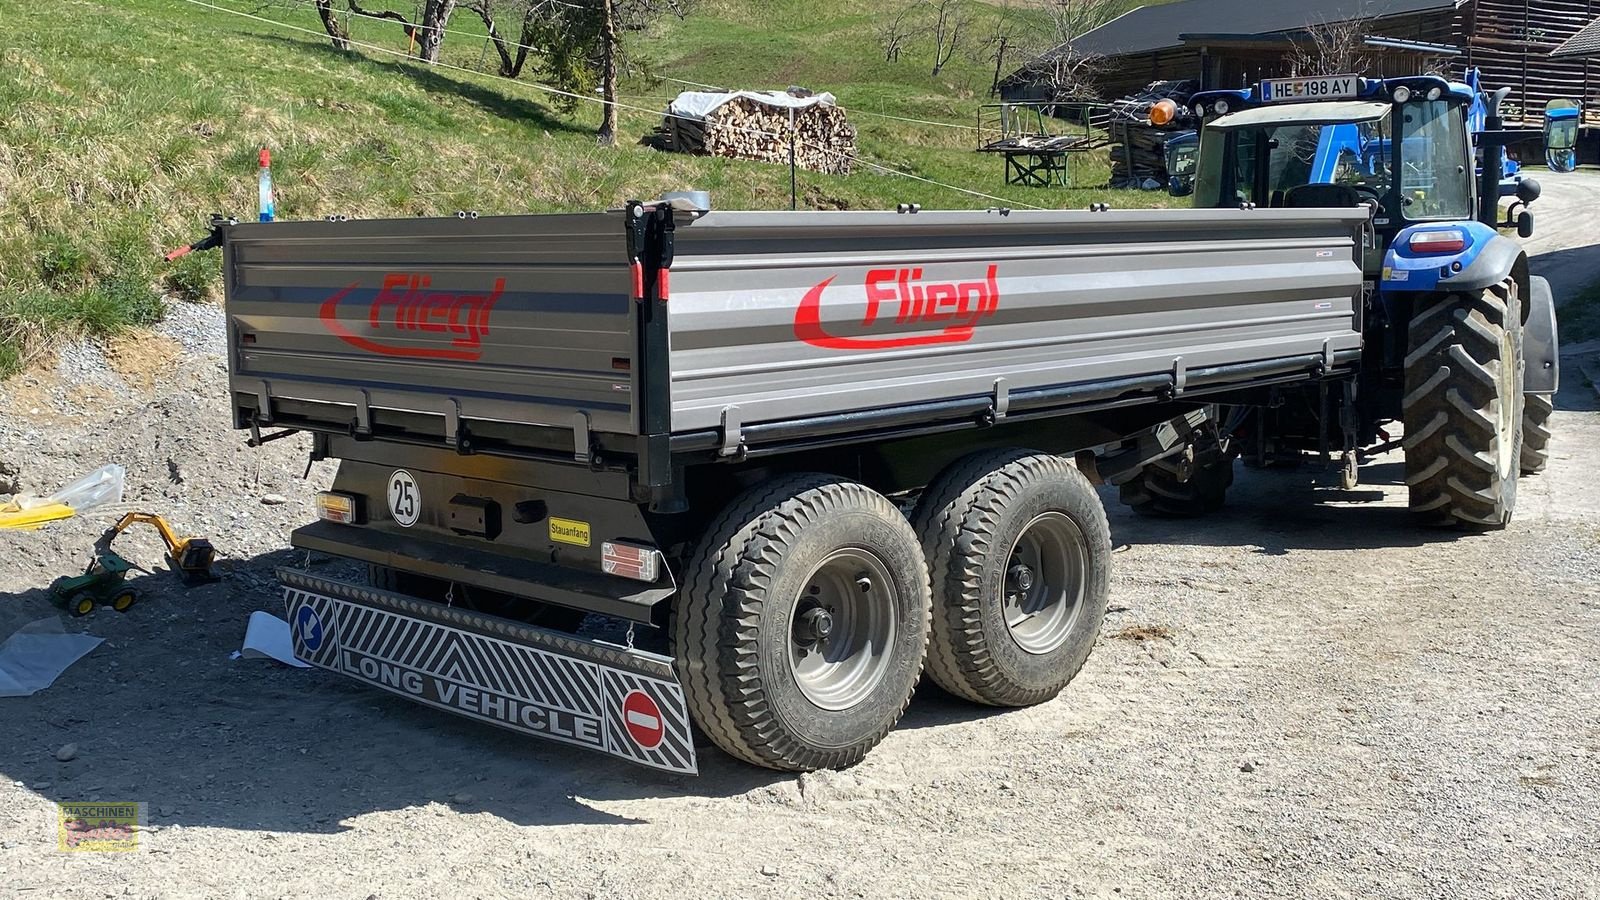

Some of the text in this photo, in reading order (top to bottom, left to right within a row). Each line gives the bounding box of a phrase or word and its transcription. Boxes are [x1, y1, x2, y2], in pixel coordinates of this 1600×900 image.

[1275, 83, 1292, 97] HE
[1304, 81, 1328, 96] 198
[1332, 79, 1350, 94] AY
[369, 272, 507, 348] Fliegl
[862, 264, 1000, 334] Fliegl
[394, 480, 414, 517] 25
[551, 523, 588, 541] Stauanfang
[343, 651, 600, 744] LONG VEHICLE
